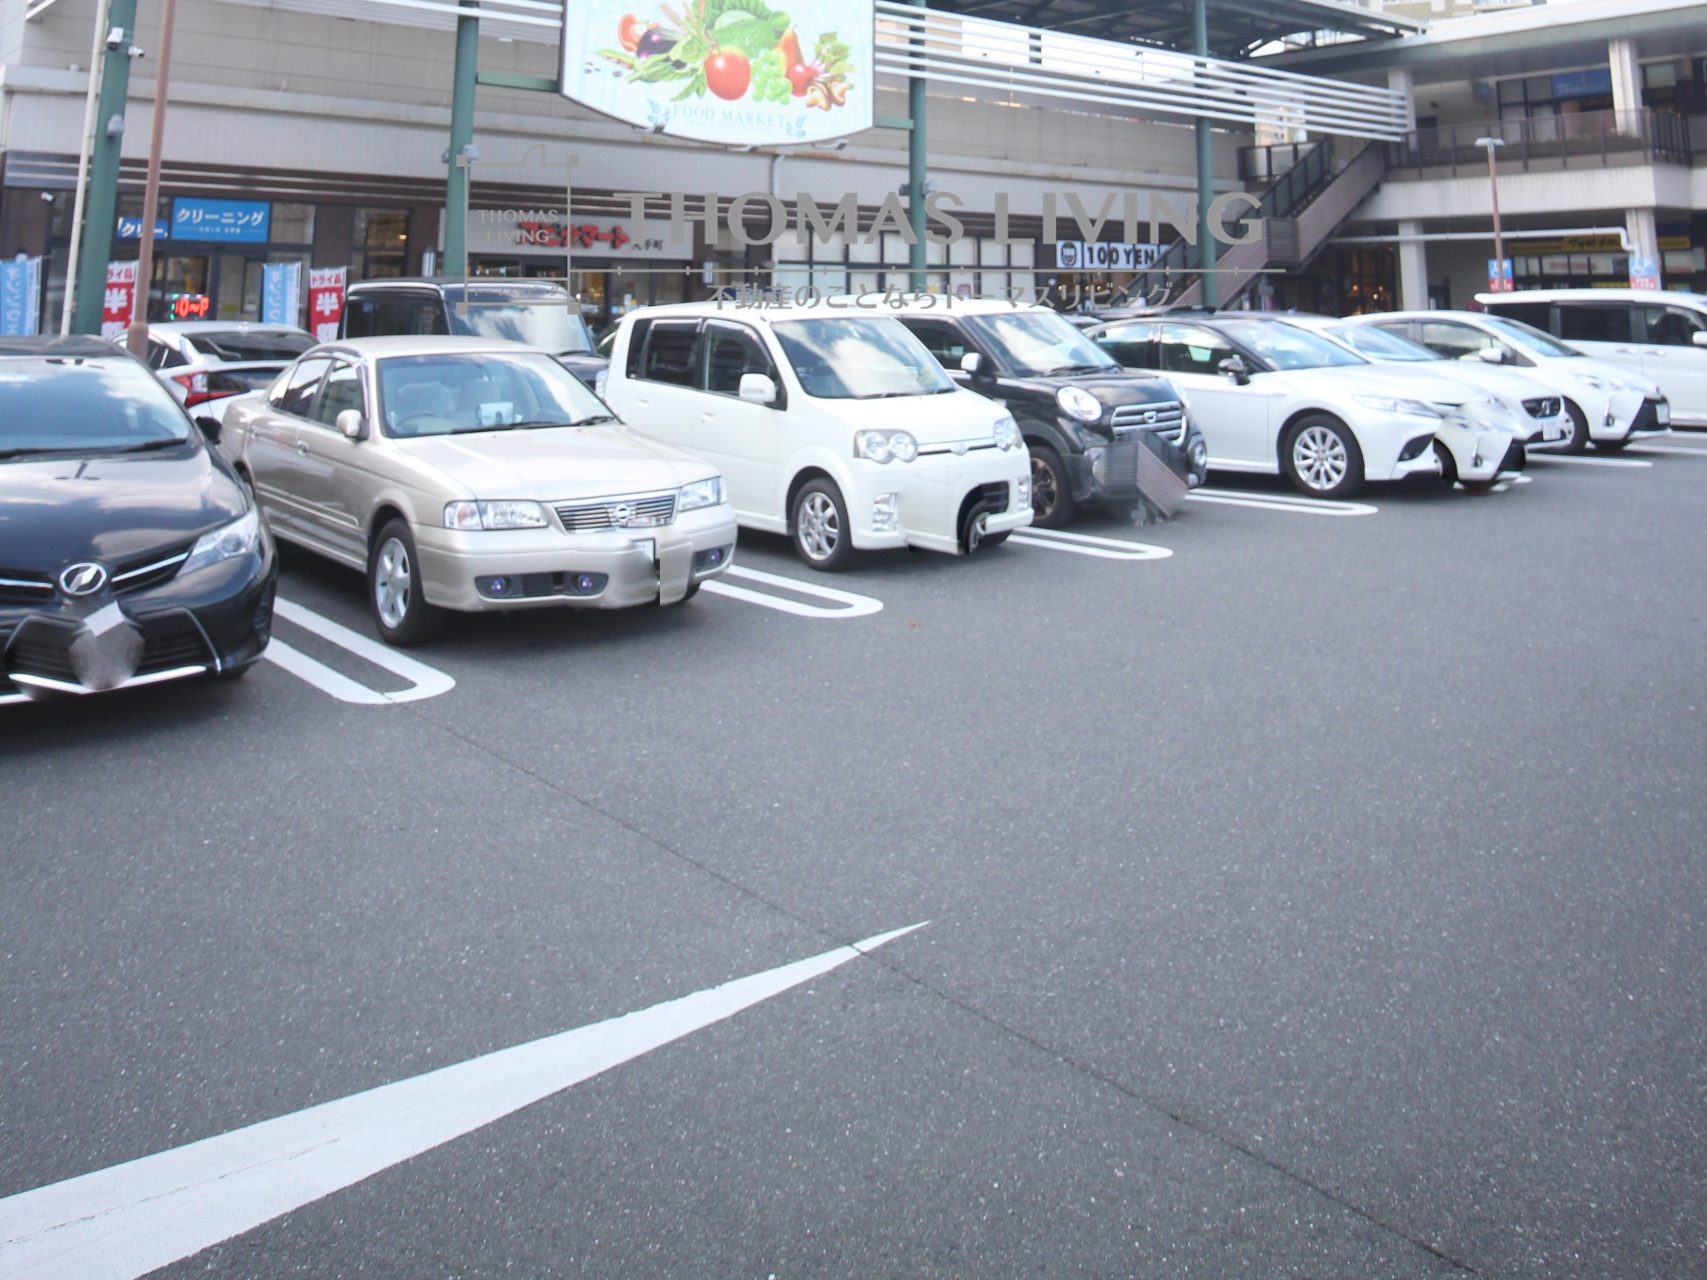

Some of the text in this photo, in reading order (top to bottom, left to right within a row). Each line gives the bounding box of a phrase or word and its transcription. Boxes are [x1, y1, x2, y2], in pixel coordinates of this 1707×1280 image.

[673, 103, 716, 121] FOOD
[720, 109, 785, 129] MARKET
[176, 208, 265, 227] クリーニング
[1087, 246, 1155, 266] 100 YEN
